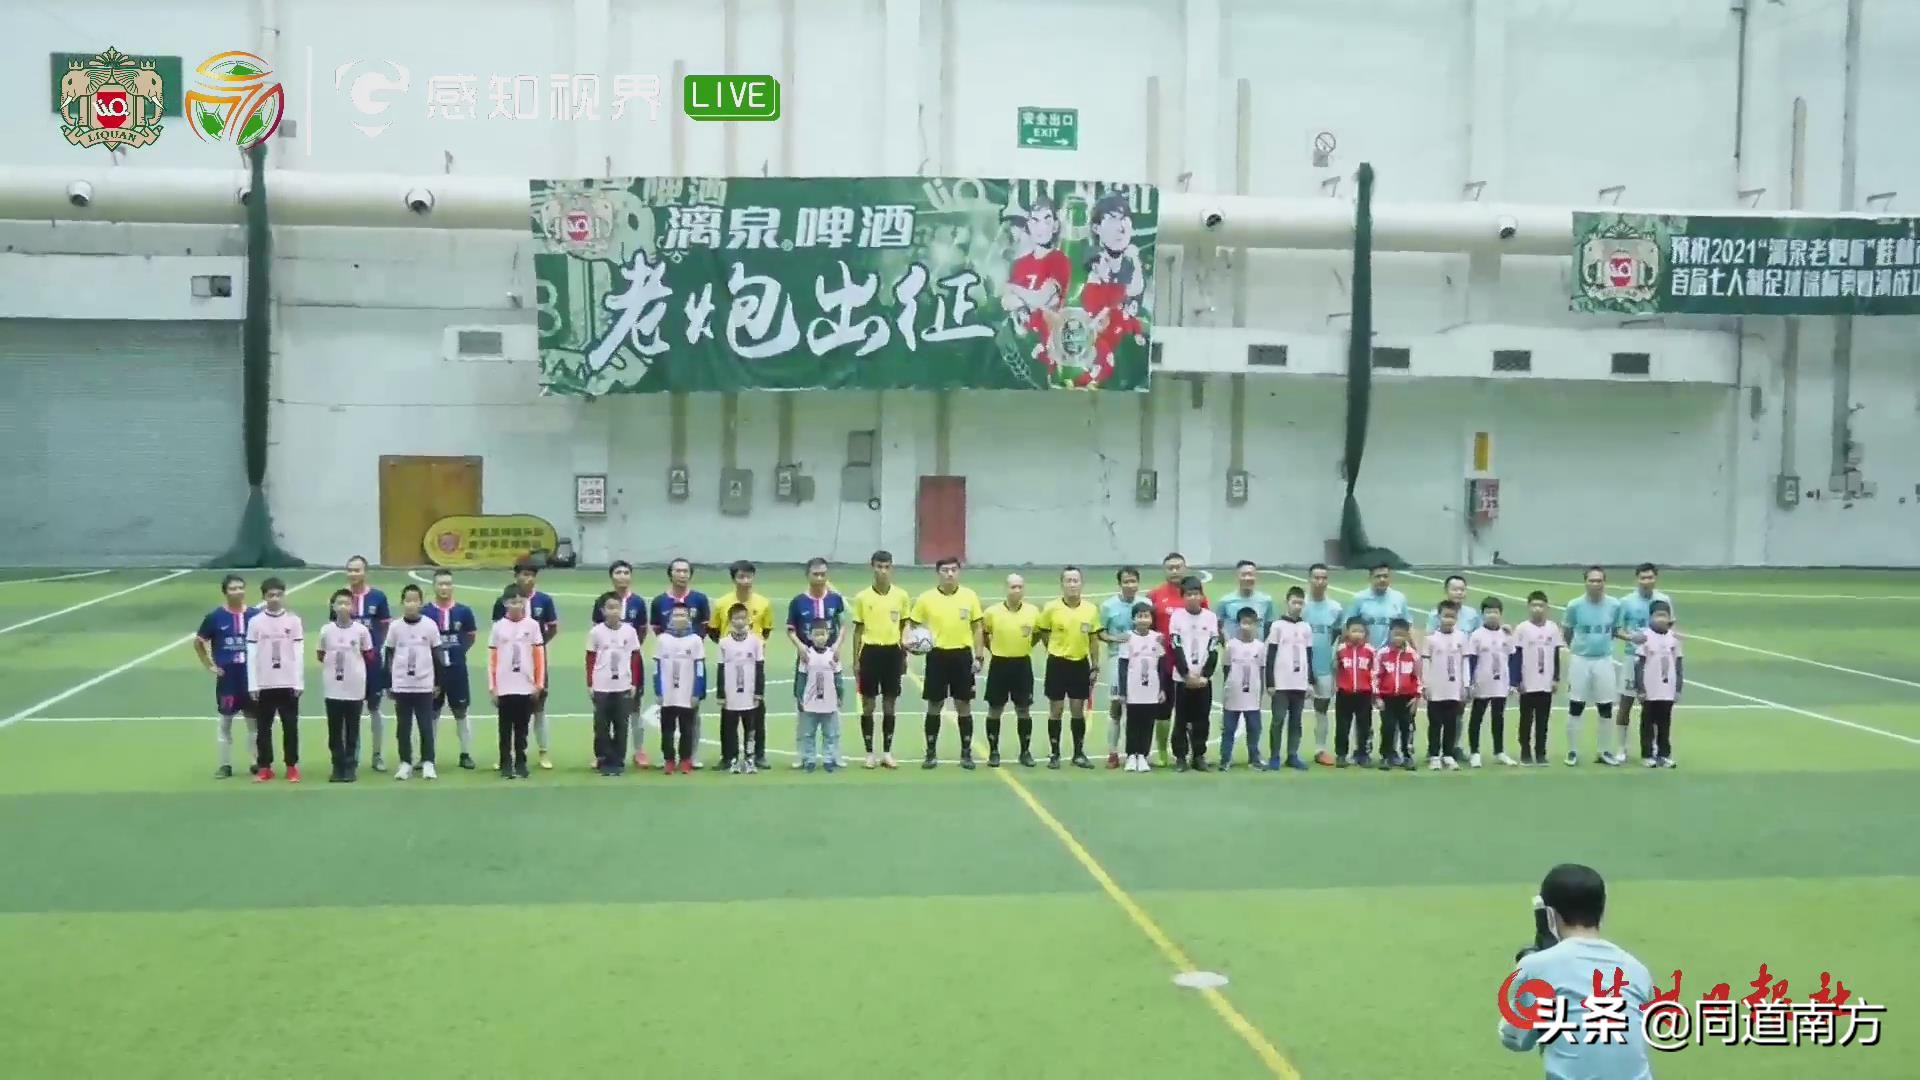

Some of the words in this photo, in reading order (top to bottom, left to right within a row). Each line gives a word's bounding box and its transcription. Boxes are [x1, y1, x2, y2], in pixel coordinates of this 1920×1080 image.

[1022, 111, 1073, 126] 安全出口
[1033, 127, 1059, 138] EXIT
[587, 251, 996, 372] 老炮出征
